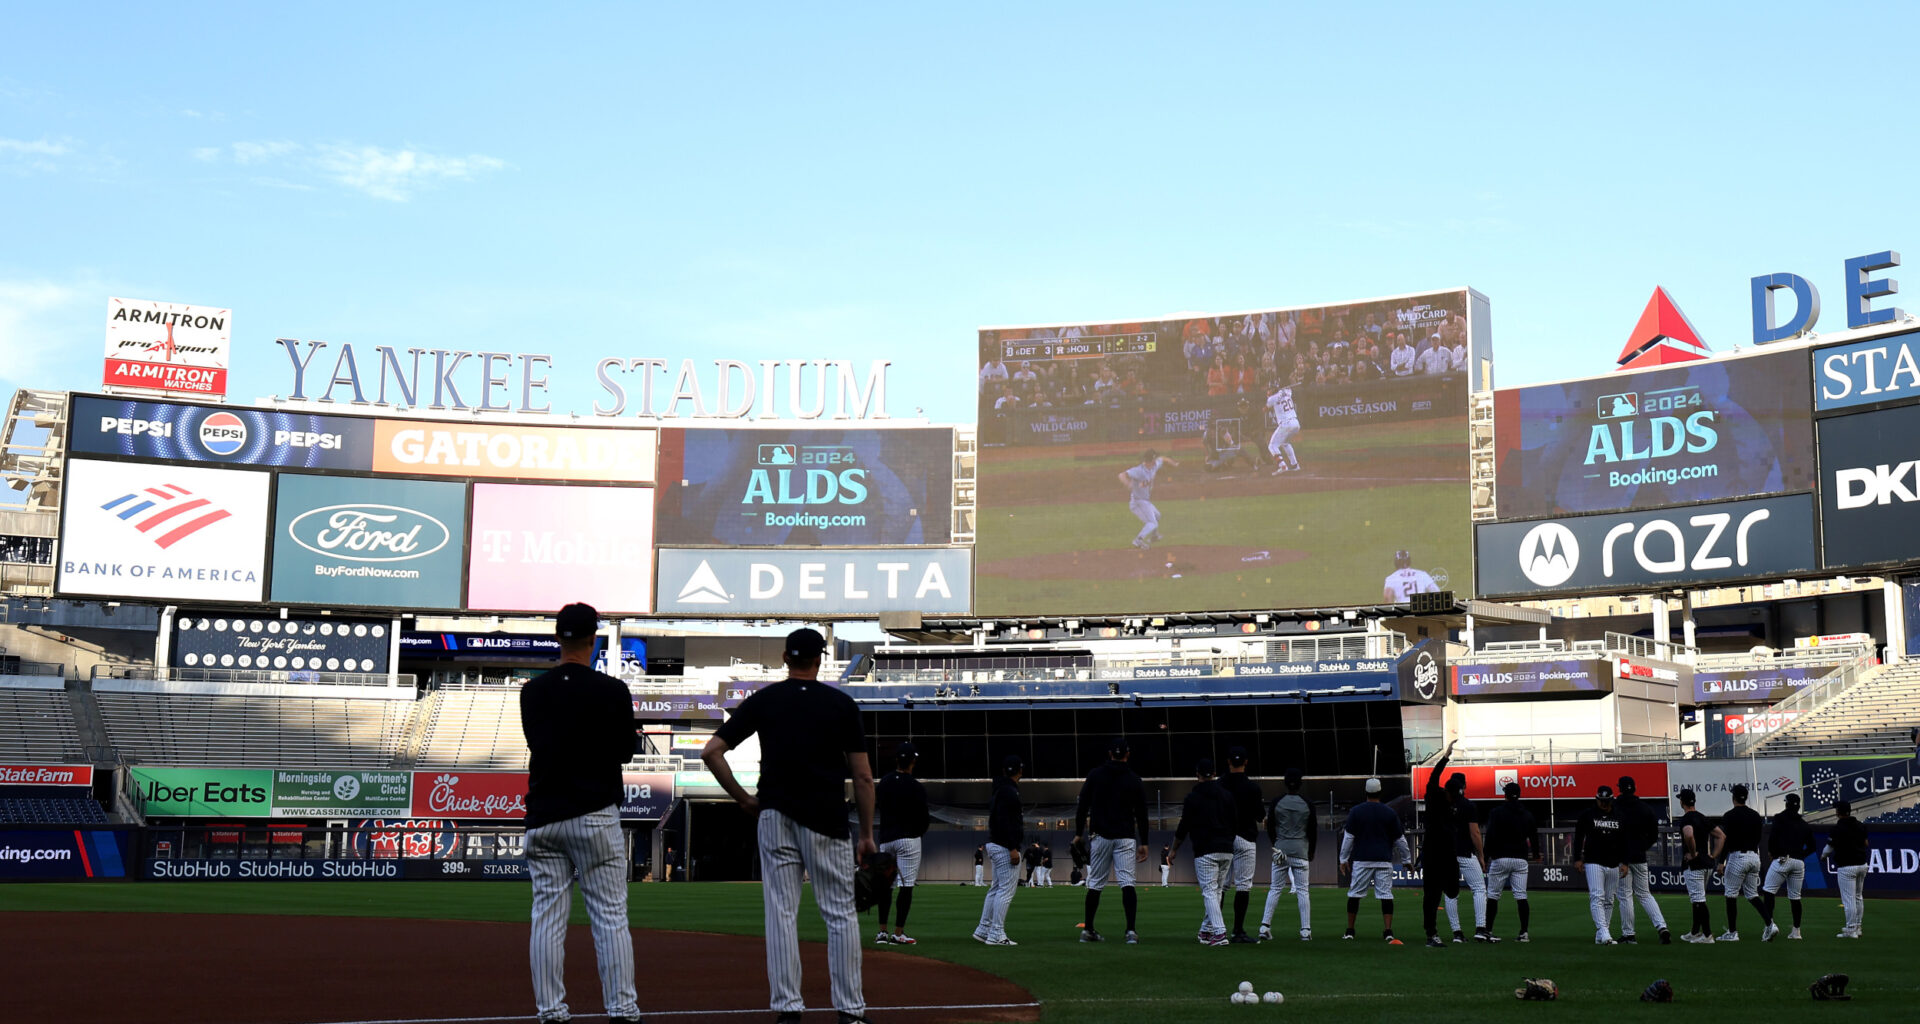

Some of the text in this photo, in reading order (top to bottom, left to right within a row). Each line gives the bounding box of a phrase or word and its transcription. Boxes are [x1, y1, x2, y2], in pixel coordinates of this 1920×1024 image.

[113, 308, 225, 331] ARMITRON
[1070, 345, 1089, 354] HOU
[115, 363, 214, 384] ARMITRON
[275, 338, 892, 420] YANKEE STADIUM
[164, 379, 213, 391] WATCHES
[1319, 401, 1398, 418] POSTSEASON
[1644, 392, 1703, 413] 2024
[1165, 409, 1211, 423] 5G HOME
[101, 417, 172, 438] PEPSI
[203, 428, 243, 439] PEPSI
[274, 430, 342, 450] PEPSI
[1583, 411, 1719, 465] ALDS
[801, 453, 856, 464] 2024
[1609, 462, 1718, 487] Booking.com
[741, 468, 868, 505] ALDS
[1835, 459, 1920, 511] DK
[765, 511, 866, 530] Booking.com
[318, 509, 423, 554] Ford
[1603, 508, 1770, 578] razr
[64, 561, 256, 583] BANK OF AMERICA
[315, 564, 419, 580] BuyFordNow.com
[749, 562, 952, 600] DELTA
[237, 636, 327, 654] New York Yankees
[484, 639, 511, 648] ALDS
[595, 660, 640, 675] ADS
[1101, 667, 1200, 679] StubHub StubHub StubHub
[1240, 661, 1388, 675] StubHub StubHub StubHub StubHub
[1481, 672, 1513, 685] ALDS
[1539, 671, 1588, 681] Booking.com
[1723, 678, 1758, 692] ALDS
[1758, 680, 1784, 688] 2024
[640, 701, 671, 712] ALDS
[278, 772, 332, 784] Morningside
[361, 772, 407, 784] Workmen's
[1522, 776, 1576, 788] TOYOTA
[204, 782, 267, 803] Eats
[381, 784, 406, 795] Circle
[1705, 783, 1718, 792] OF
[1720, 782, 1770, 792] AMRICA
[282, 808, 401, 816] WWW.CASSENACARE.COM
[619, 806, 651, 815] Multiply
[1593, 819, 1619, 829] YANKEES
[1868, 848, 1920, 874] ALD
[153, 860, 397, 878] StubHub StubHub StubHub
[483, 864, 520, 874] STARR
